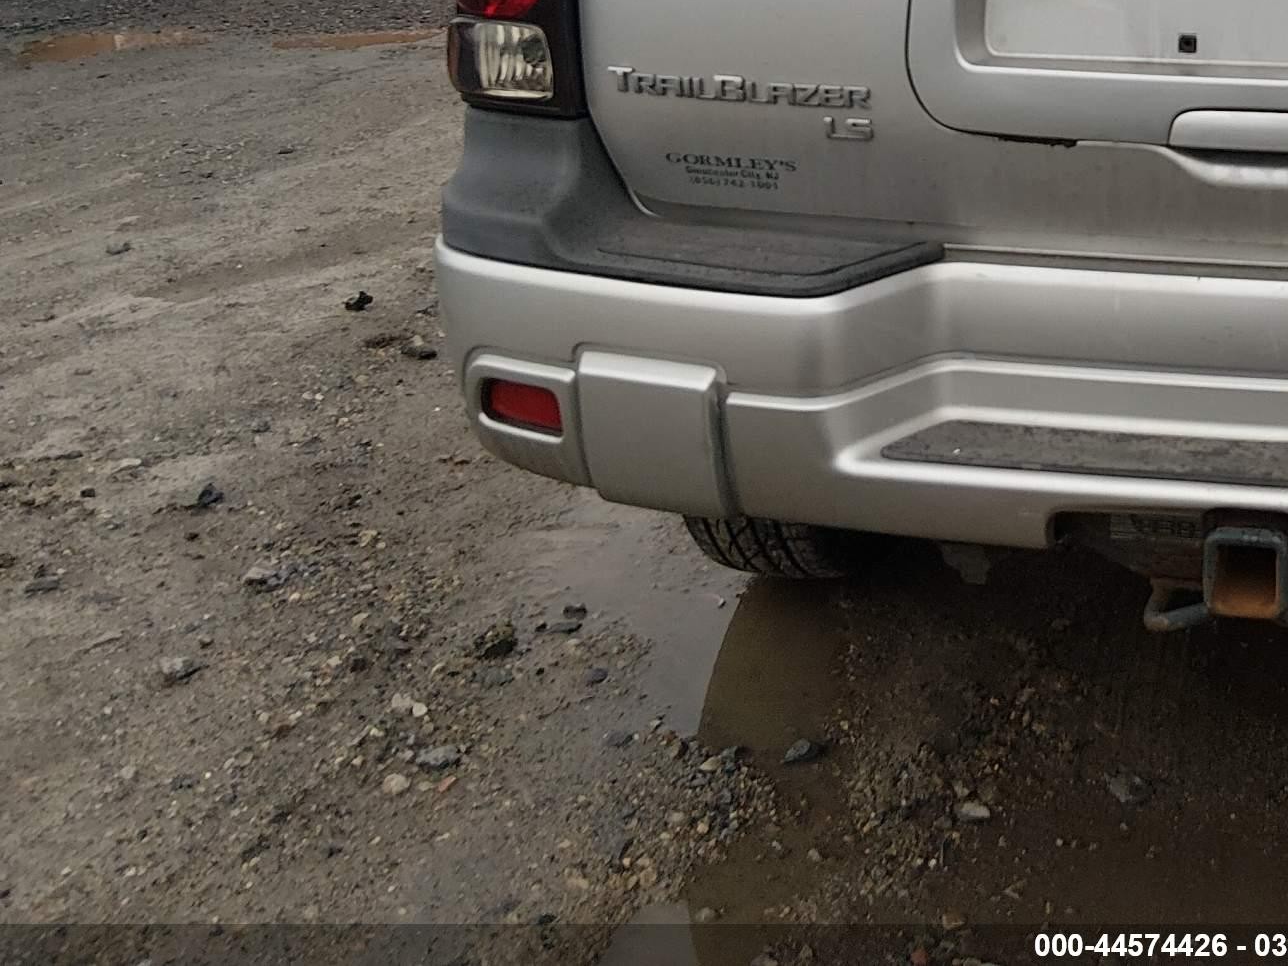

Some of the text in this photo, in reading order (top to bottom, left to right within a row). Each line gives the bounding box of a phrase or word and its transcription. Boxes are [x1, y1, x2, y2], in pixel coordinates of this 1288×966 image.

[607, 65, 872, 110] TRAILBLAZER
[823, 116, 873, 141] LS
[665, 152, 798, 172] GORMLEY'S
